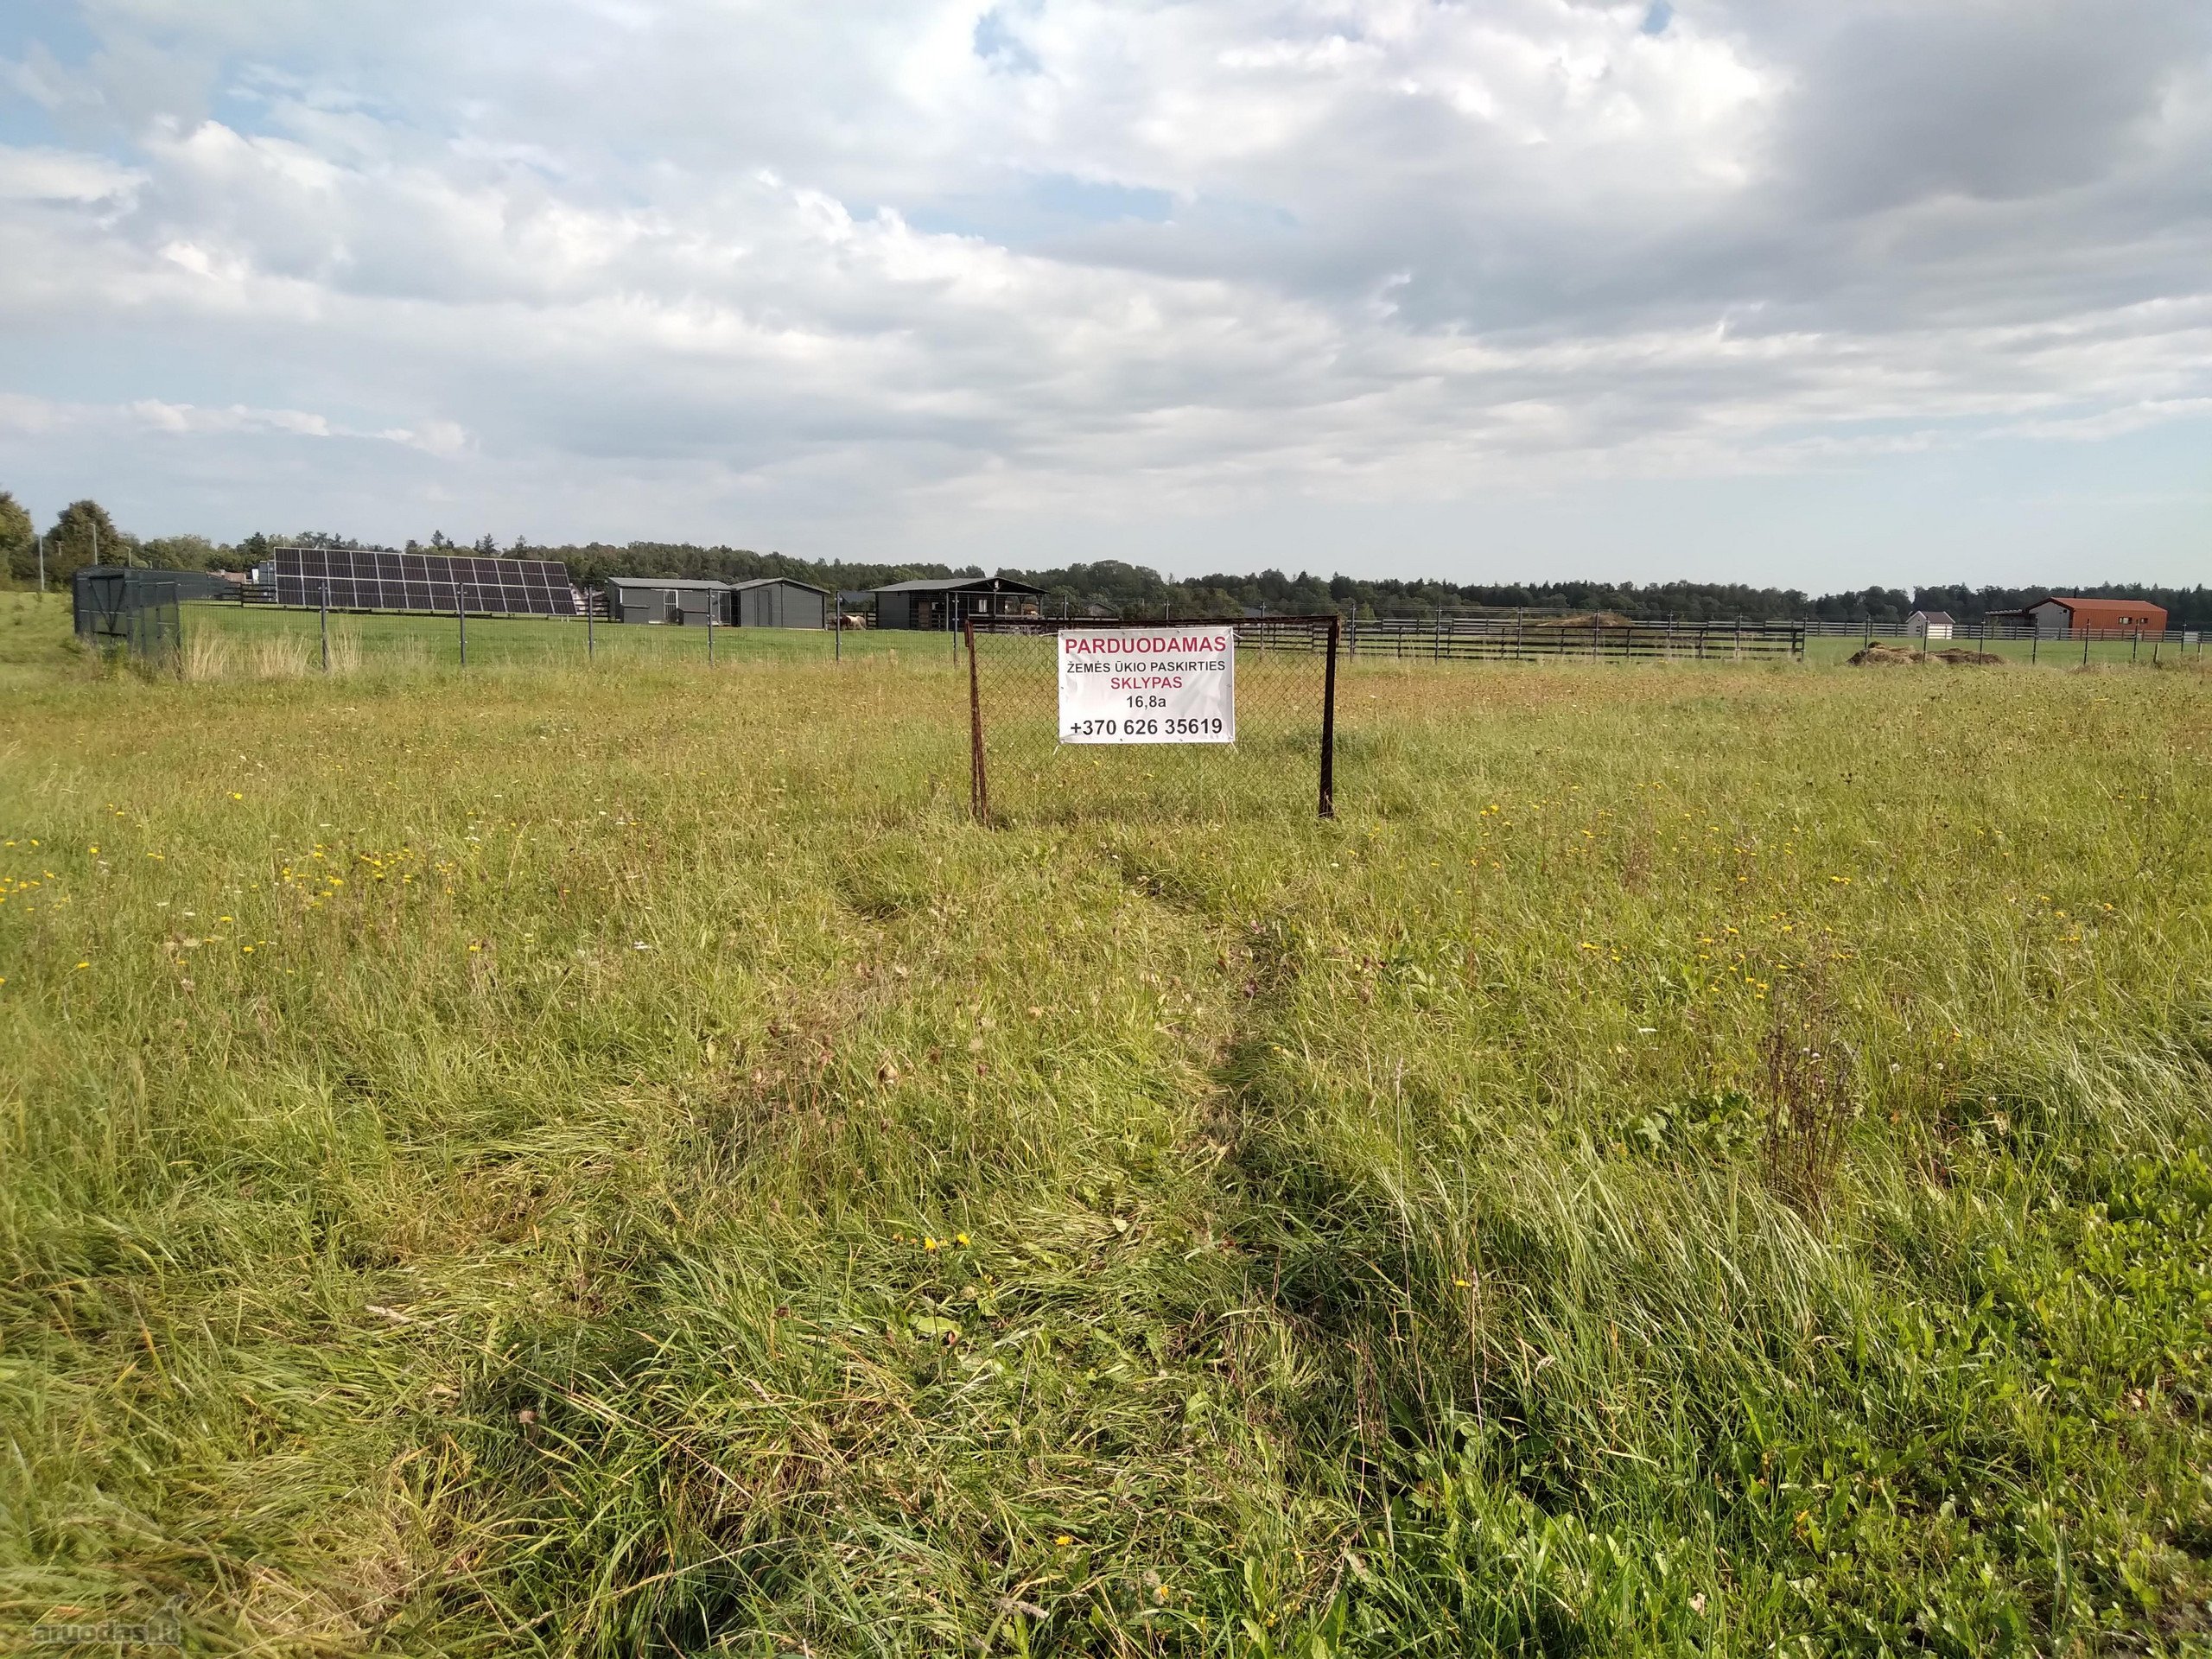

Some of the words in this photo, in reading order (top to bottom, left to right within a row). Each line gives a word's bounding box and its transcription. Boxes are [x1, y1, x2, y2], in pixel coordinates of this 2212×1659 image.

[1065, 636, 1226, 654] PARDUODAMAS
[1066, 660, 1111, 673] ŽEMĖS
[1115, 660, 1147, 672] ŪKIO
[1150, 660, 1225, 671] PASKIRTIES
[1110, 676, 1183, 690] SKLYPAS
[1126, 695, 1166, 710] 16,8a
[1071, 719, 1116, 735] +370
[1123, 719, 1158, 734] 626
[1165, 718, 1223, 734] 35619
